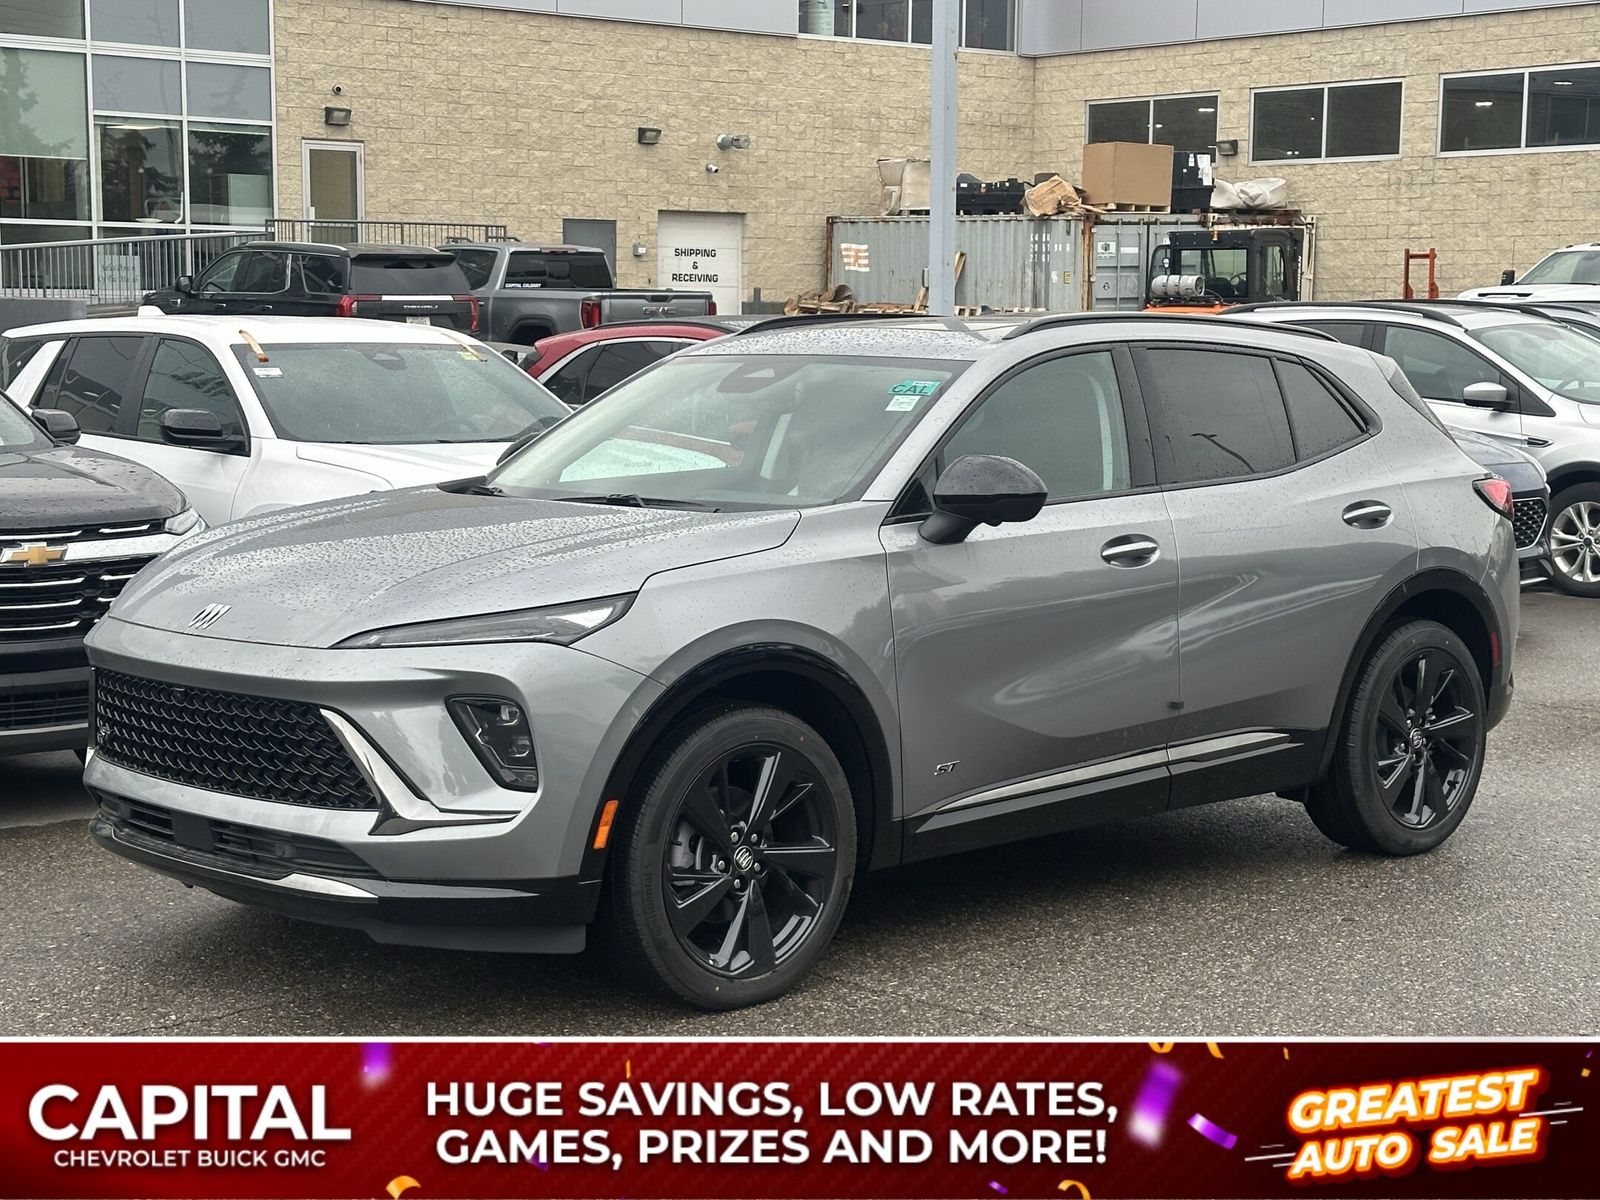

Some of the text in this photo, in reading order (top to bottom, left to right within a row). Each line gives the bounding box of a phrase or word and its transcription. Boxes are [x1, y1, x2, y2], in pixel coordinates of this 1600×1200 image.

[674, 248, 717, 258] SHIPPING
[692, 261, 699, 270] &
[671, 273, 719, 283] RECEIVING
[891, 384, 929, 395] CAL
[934, 760, 960, 776] ST
